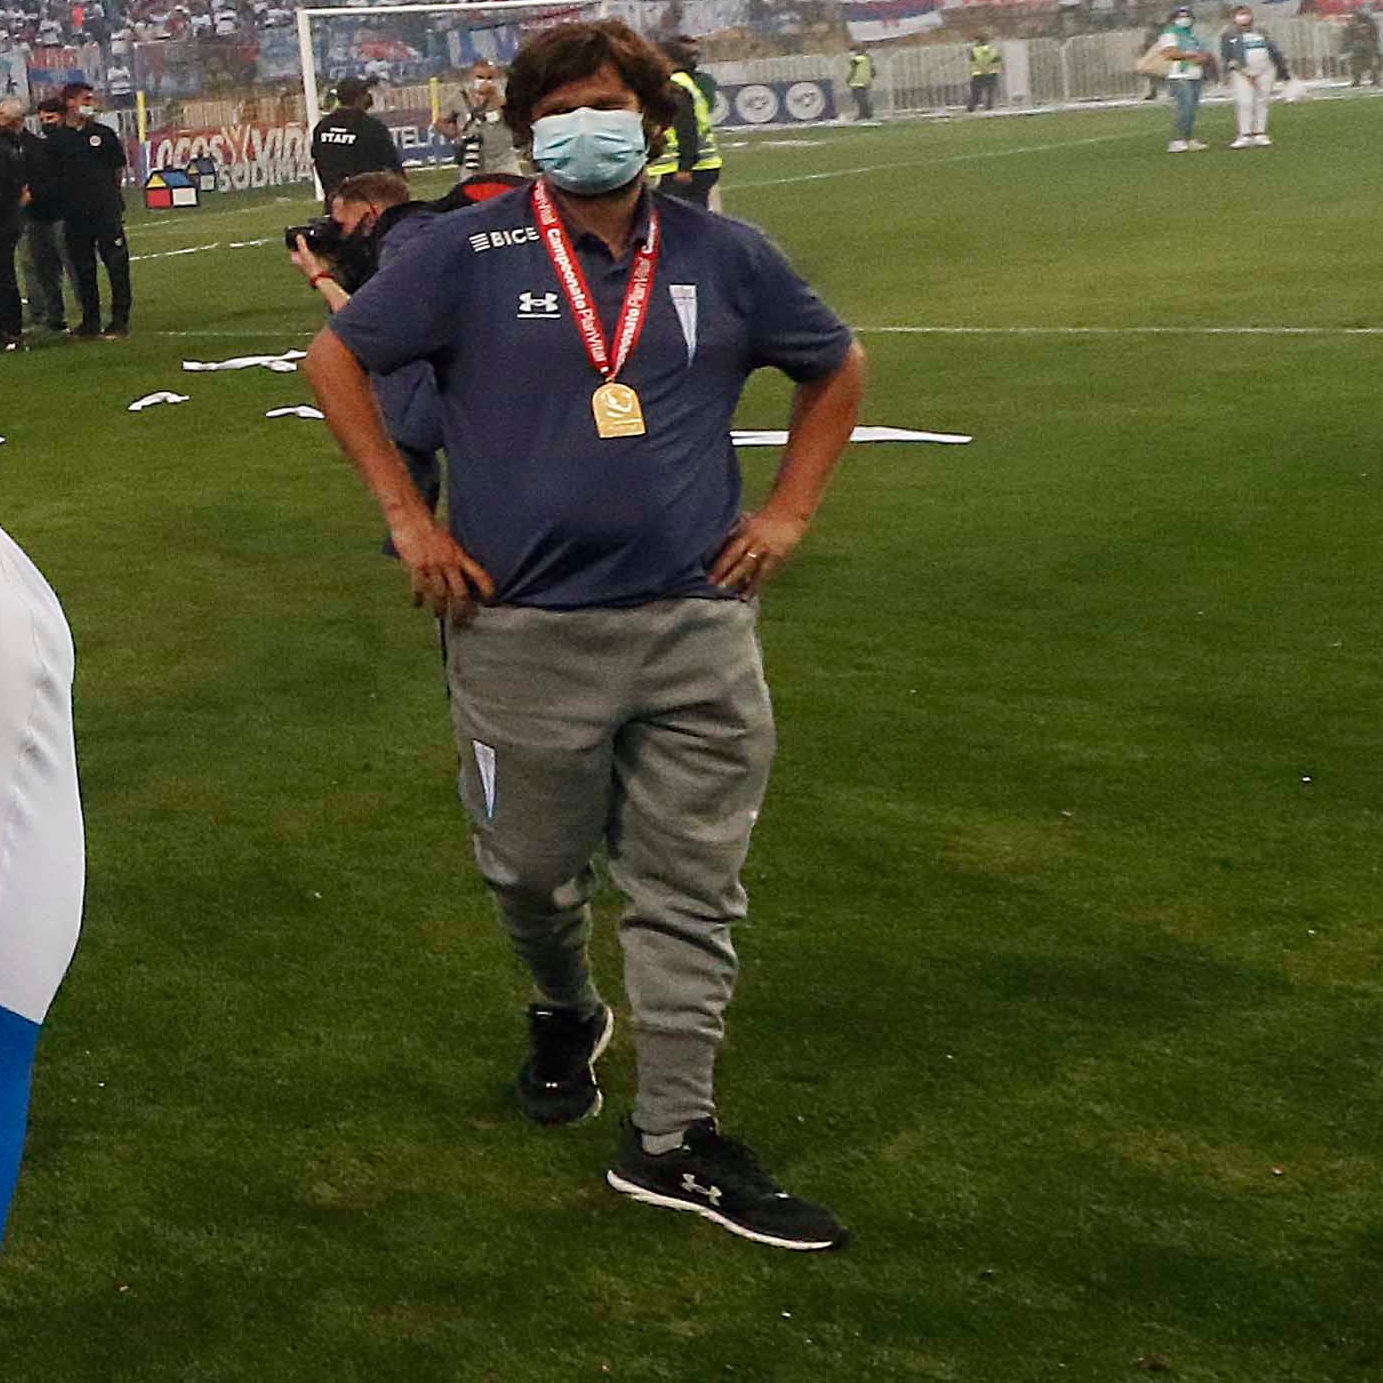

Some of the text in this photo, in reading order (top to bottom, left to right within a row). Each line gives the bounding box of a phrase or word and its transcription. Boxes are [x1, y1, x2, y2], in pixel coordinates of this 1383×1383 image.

[320, 133, 357, 145] STAFF
[490, 226, 541, 248] BICE
[546, 228, 587, 310] Campeonato
